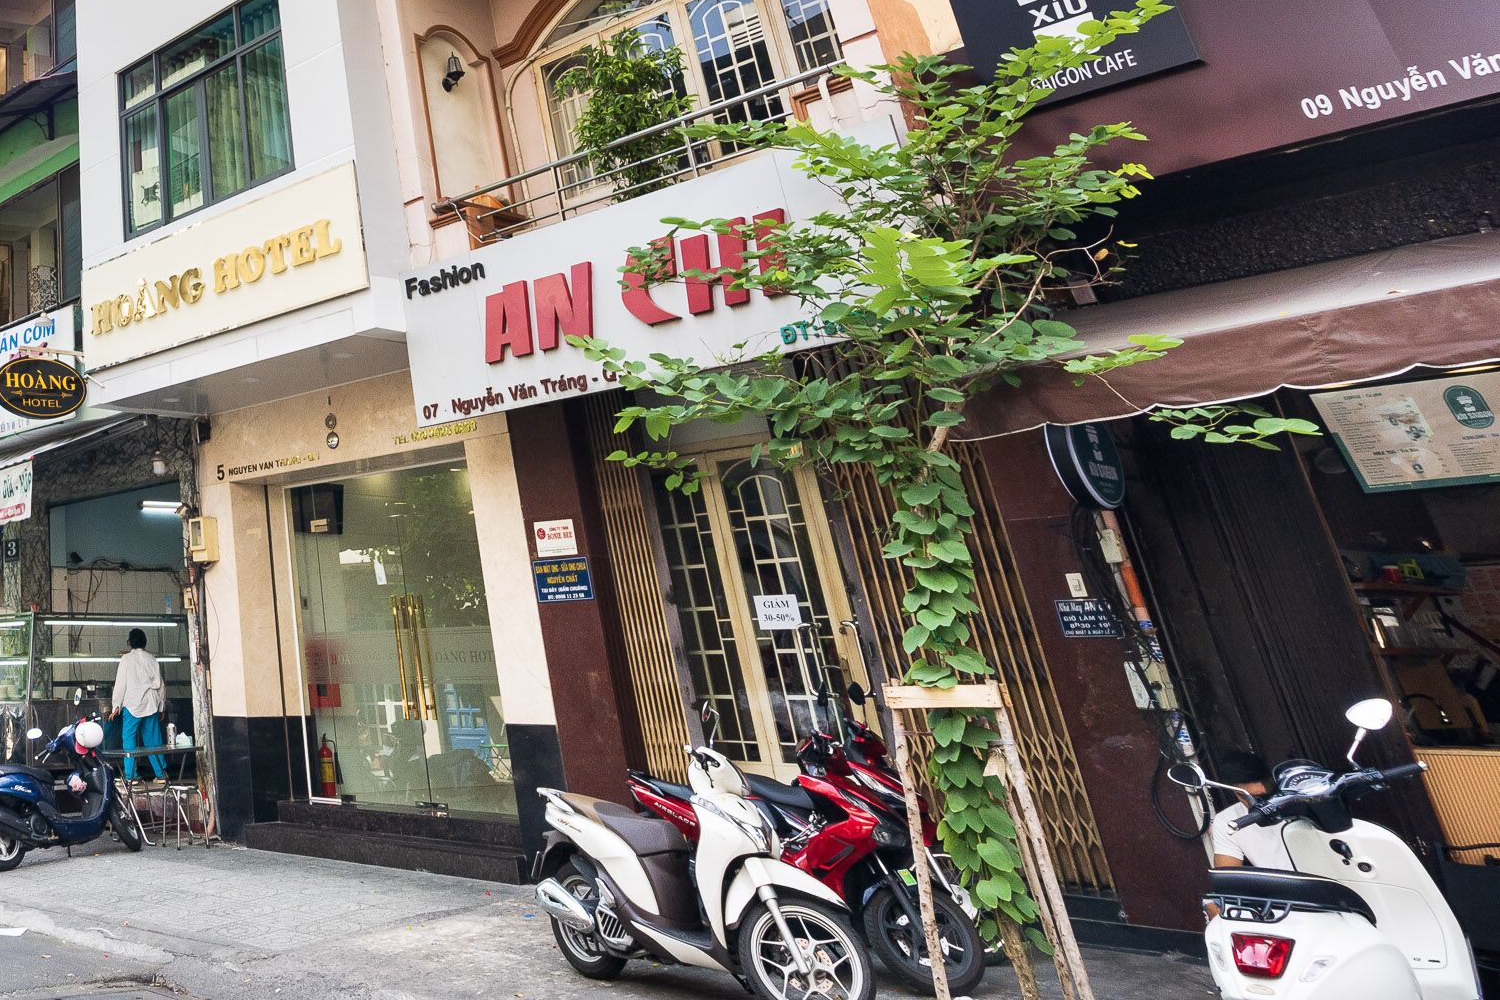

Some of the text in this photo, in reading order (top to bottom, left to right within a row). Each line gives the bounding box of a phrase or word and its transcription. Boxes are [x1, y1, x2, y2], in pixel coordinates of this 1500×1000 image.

[1093, 48, 1138, 77] CAFE
[1301, 94, 1333, 119] 09
[1338, 65, 1448, 110] Nguyễn
[213, 218, 343, 295] HOTEL
[404, 262, 486, 300] Fashion
[485, 208, 785, 365] AN CHI
[5, 369, 77, 391] HOÀNG
[22, 398, 63, 408] HOTEL
[422, 403, 440, 420] 07
[451, 386, 505, 416] Nguyễn
[508, 383, 538, 402] Văn
[540, 374, 588, 395] Tráng
[216, 464, 226, 481] 5
[228, 464, 258, 477] NGUYEN
[259, 461, 274, 471] VAN
[7, 541, 17, 557] 3
[764, 613, 795, 622] 30-50%
